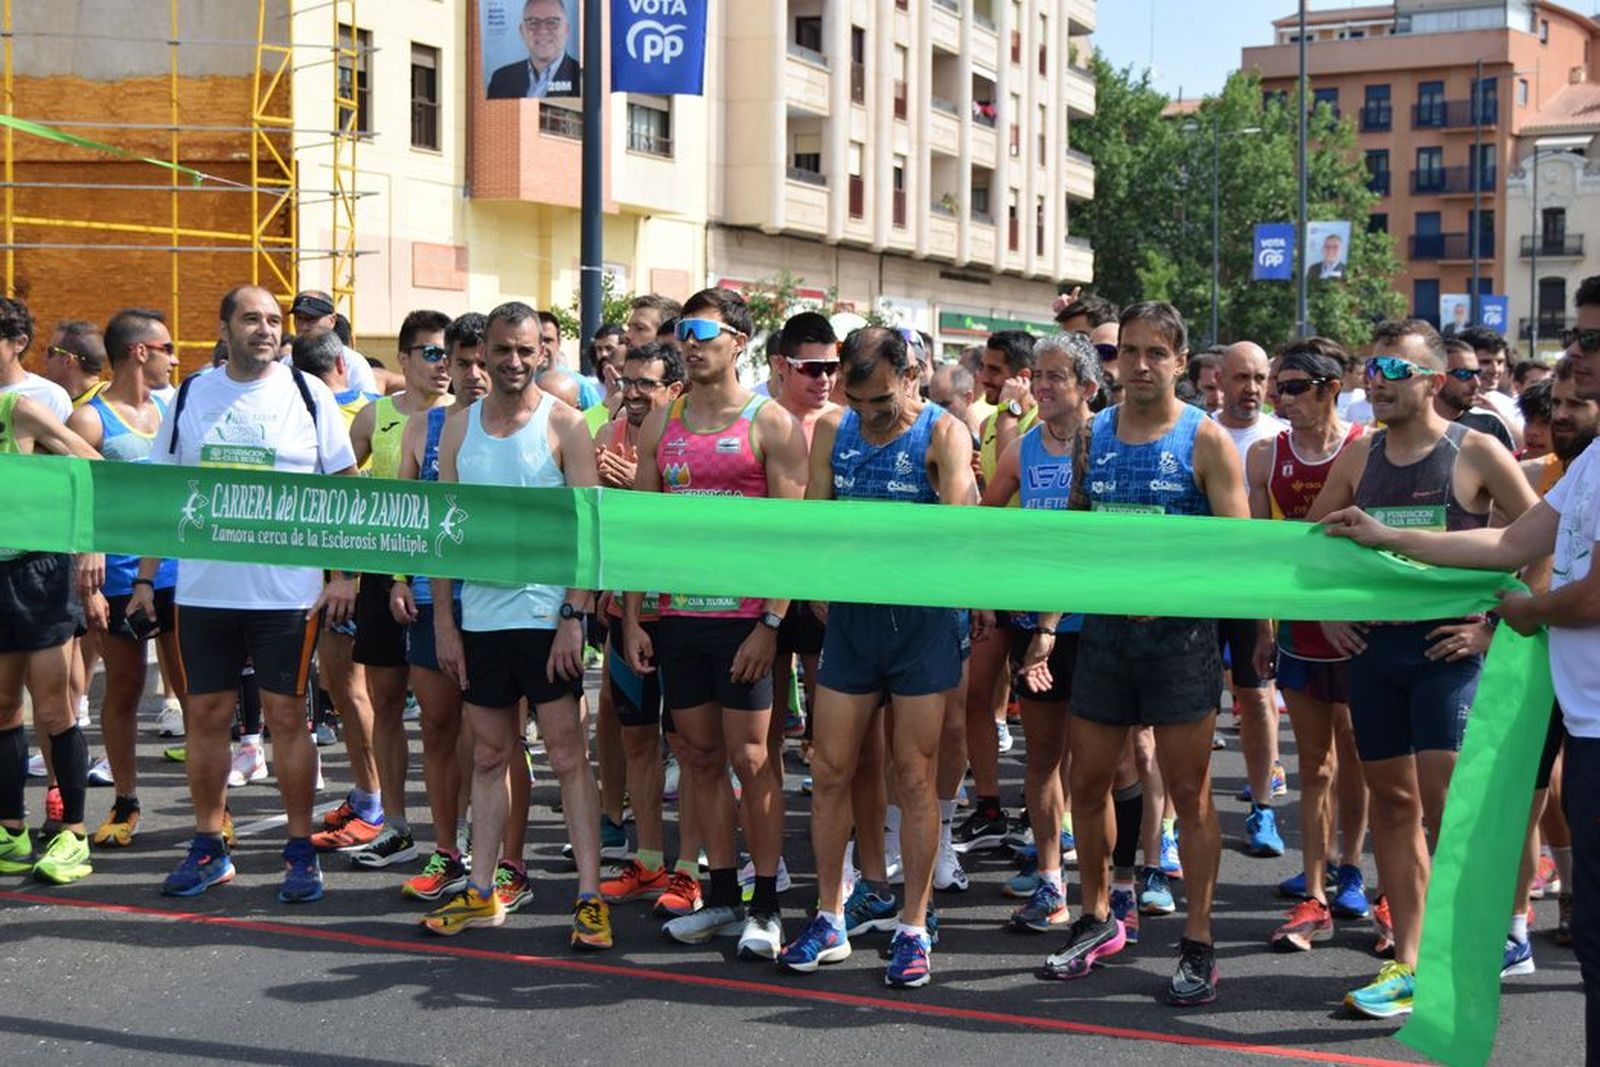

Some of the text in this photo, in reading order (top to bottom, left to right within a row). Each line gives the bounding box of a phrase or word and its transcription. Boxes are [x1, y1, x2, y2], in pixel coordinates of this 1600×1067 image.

[629, 0, 687, 15] VOTA
[211, 483, 430, 530] CARRERA del CERCO de ZAMORA
[211, 524, 429, 556] Zamora cerca de la Esclerosis Múltiple
